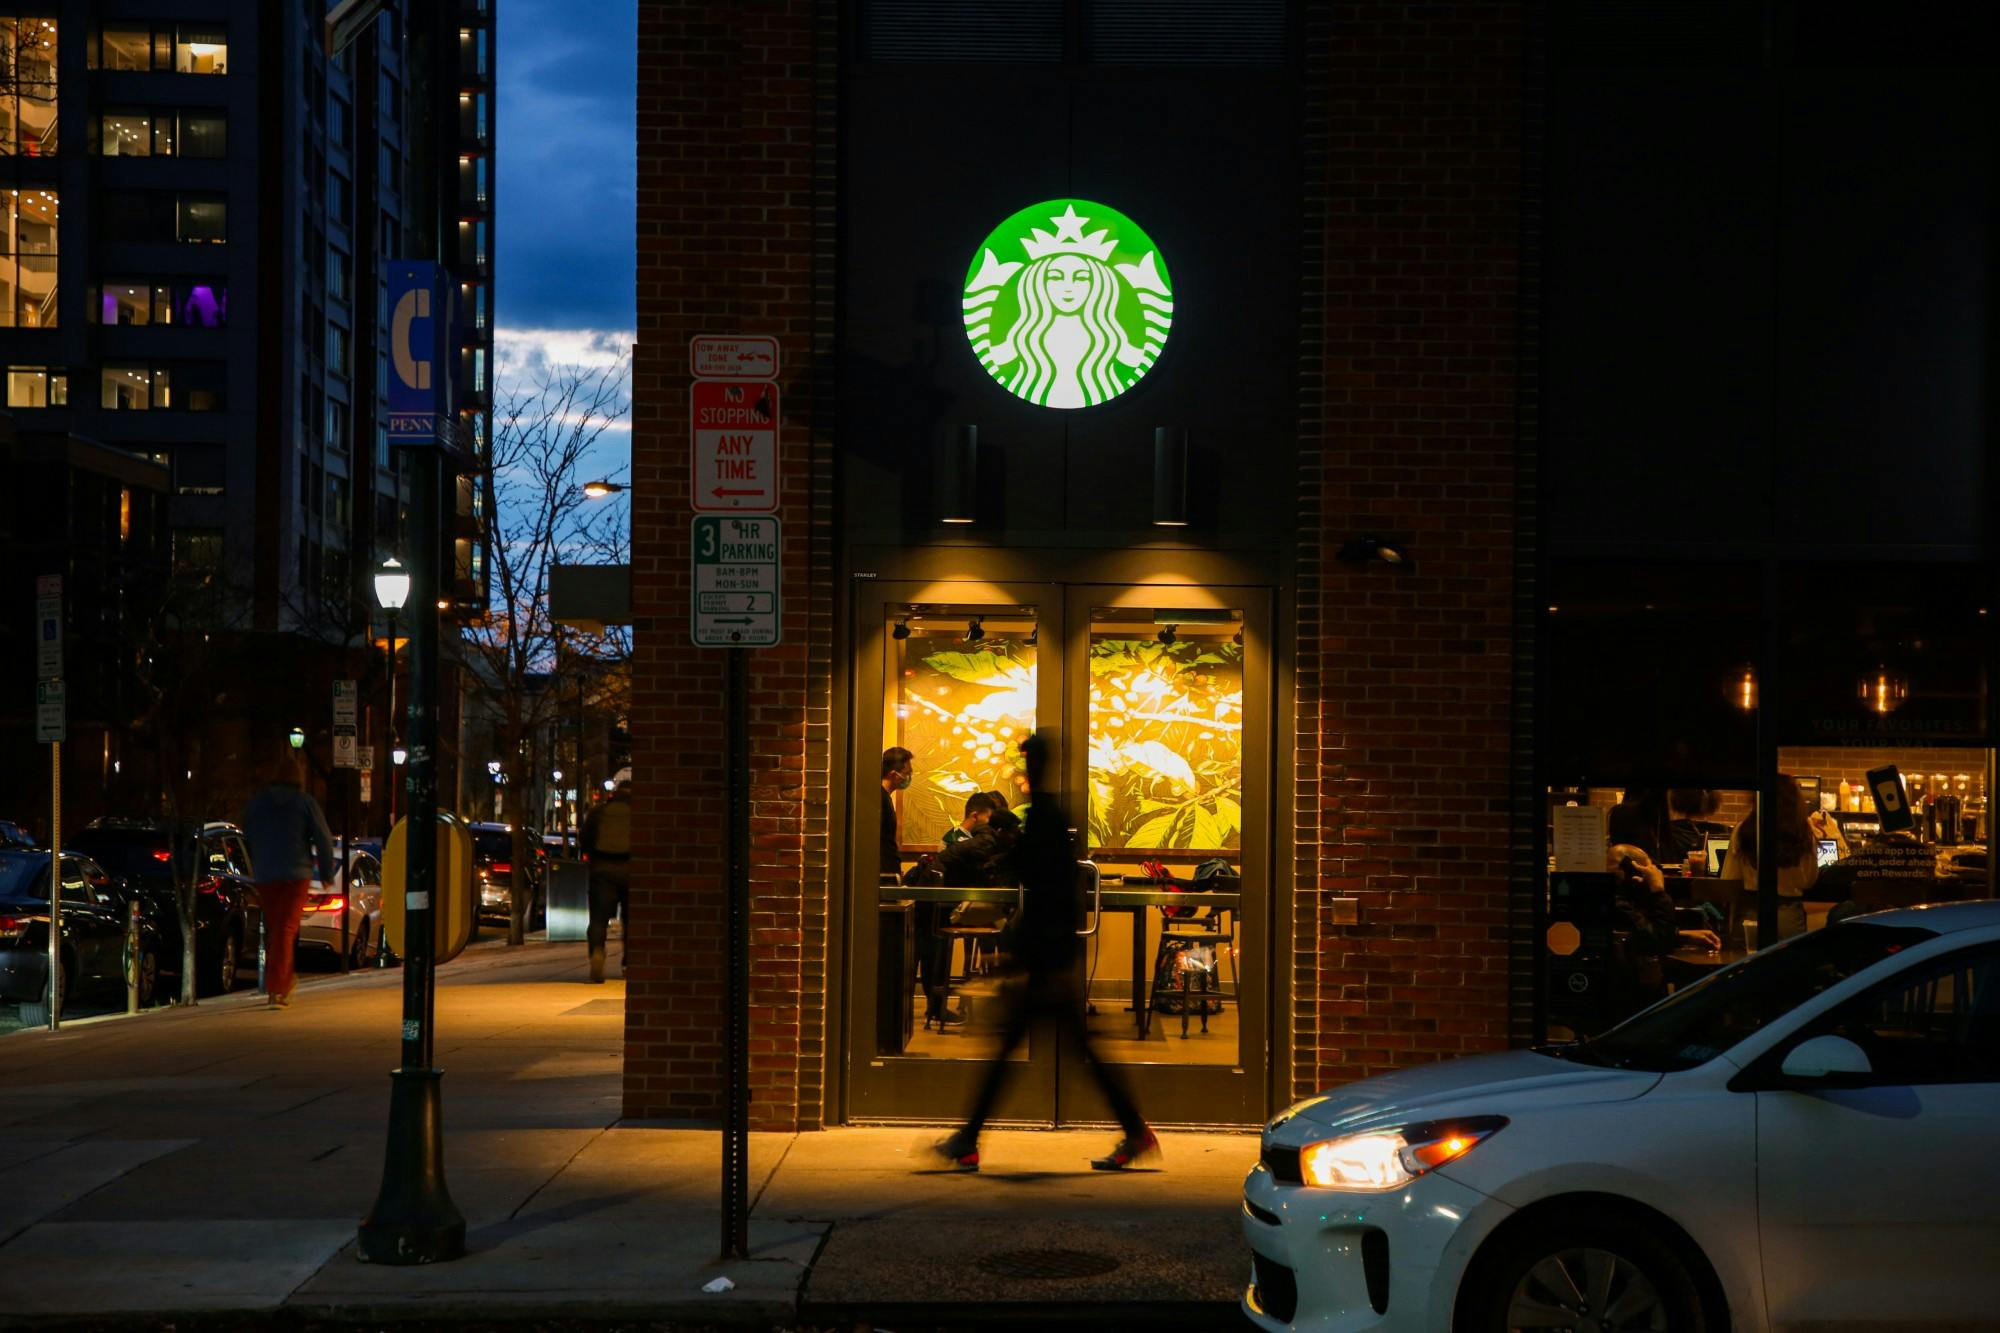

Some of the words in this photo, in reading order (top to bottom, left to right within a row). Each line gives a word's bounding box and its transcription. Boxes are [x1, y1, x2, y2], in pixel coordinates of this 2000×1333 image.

[696, 343, 714, 352] TOW
[717, 343, 740, 352] AWAY
[708, 353, 728, 362] ZONE
[724, 386, 745, 404] NO
[390, 418, 433, 432] PENN
[716, 434, 754, 455] ANY
[715, 459, 757, 480] TIME
[701, 524, 715, 557] 3
[739, 522, 760, 539] HR
[722, 543, 774, 560] PARKING
[715, 579, 759, 589] MON-SUN
[746, 595, 755, 611] 2
[1811, 719, 1858, 731] YOUR
[1885, 848, 1904, 859] app
